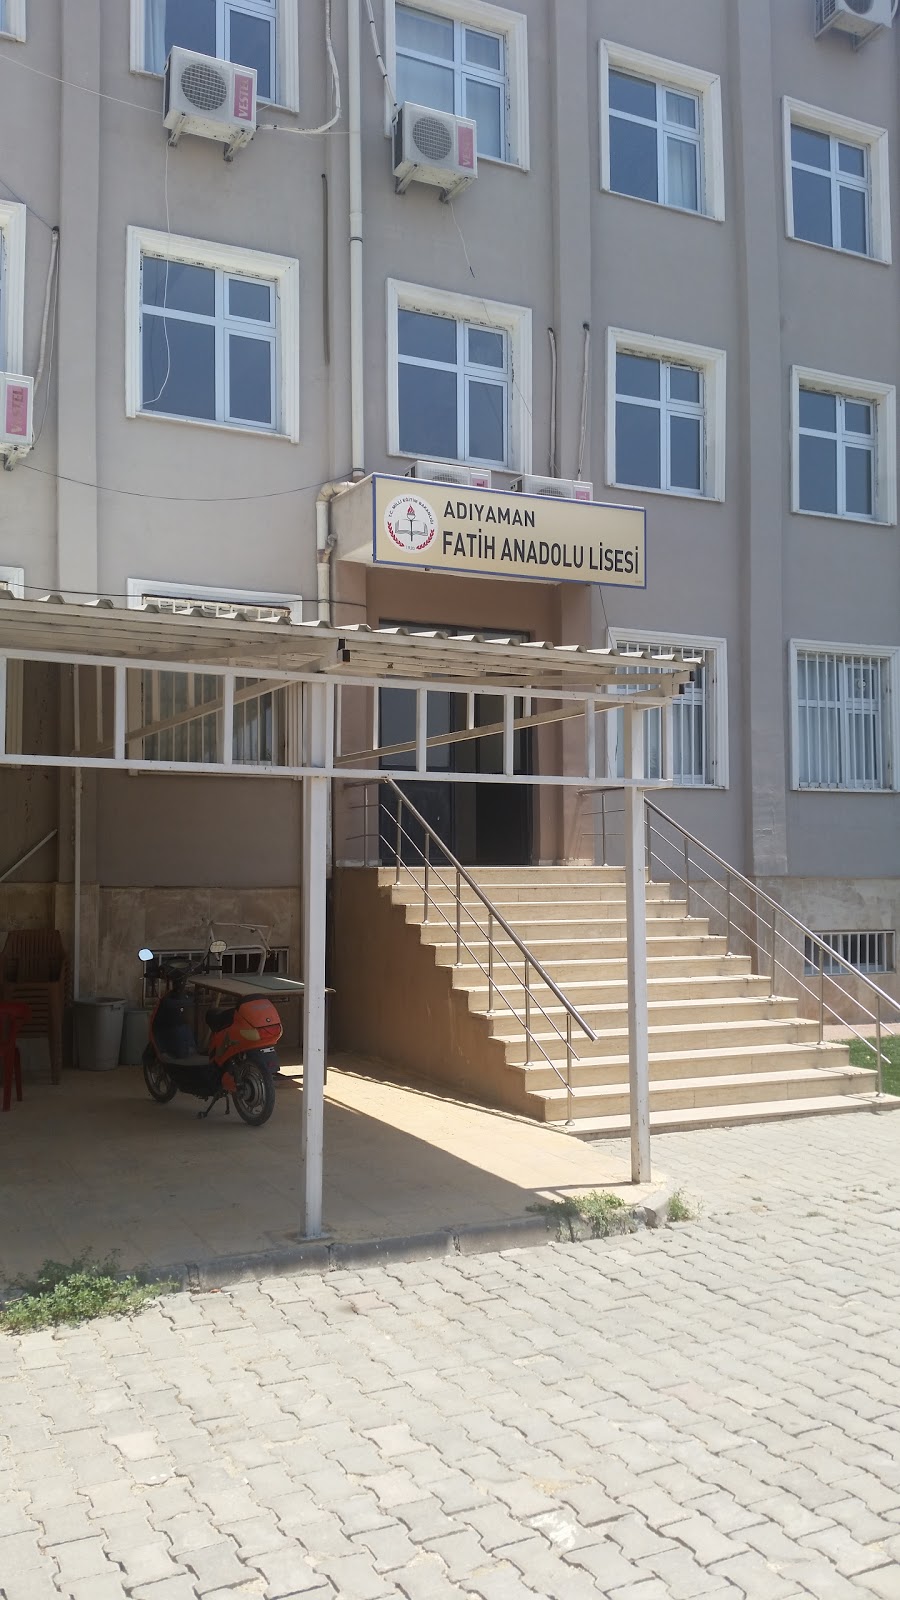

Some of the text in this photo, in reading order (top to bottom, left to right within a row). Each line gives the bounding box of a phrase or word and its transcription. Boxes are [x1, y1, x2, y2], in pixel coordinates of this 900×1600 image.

[238, 79, 249, 117] VESTEL
[443, 500, 535, 528] ADIYAMAN
[442, 528, 639, 575] FATİH ANADOLU LİSESİ
